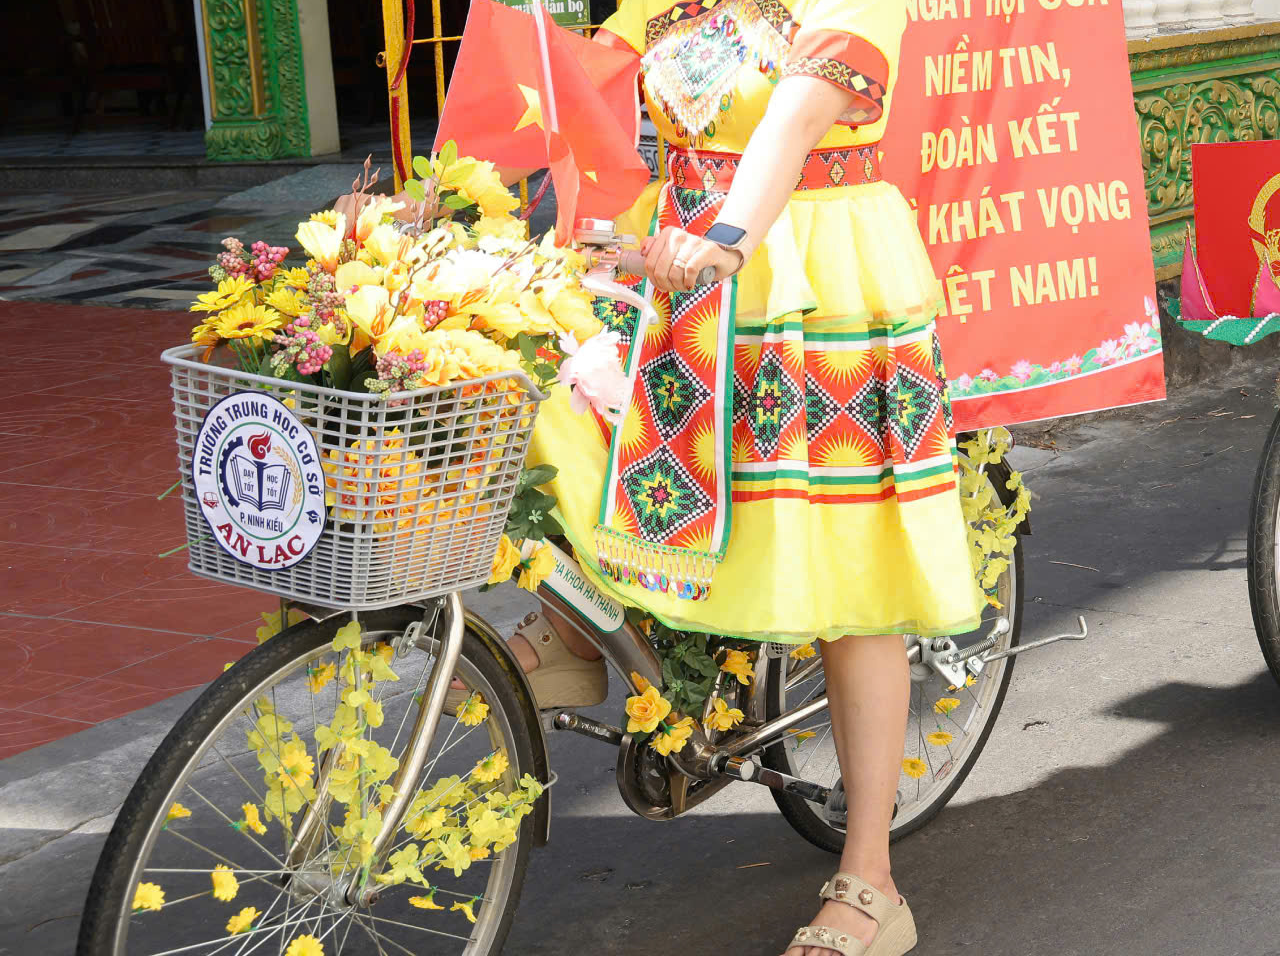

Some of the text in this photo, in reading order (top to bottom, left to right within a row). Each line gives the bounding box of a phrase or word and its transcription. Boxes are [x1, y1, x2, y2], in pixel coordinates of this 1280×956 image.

[924, 34, 1071, 97] NIỀM TIN,
[920, 96, 1080, 173] ĐOÀN KẾT
[929, 186, 1025, 245] KHÁT
[1036, 180, 1131, 234] VỌNG
[936, 256, 1099, 323] IỆT NAM!
[199, 401, 323, 497] TRƯỜNG TRUNG HỌC CƠ SỞ
[243, 468, 279, 486] DẠY HỌC
[244, 481, 278, 497] TỐT TỐT
[216, 522, 305, 567] AN LẠC
[240, 512, 246, 523] P.
[247, 515, 265, 529] NINH
[563, 569, 584, 593] KHOA
[583, 586, 597, 602] HÀ
[594, 594, 620, 622] THÀNH
